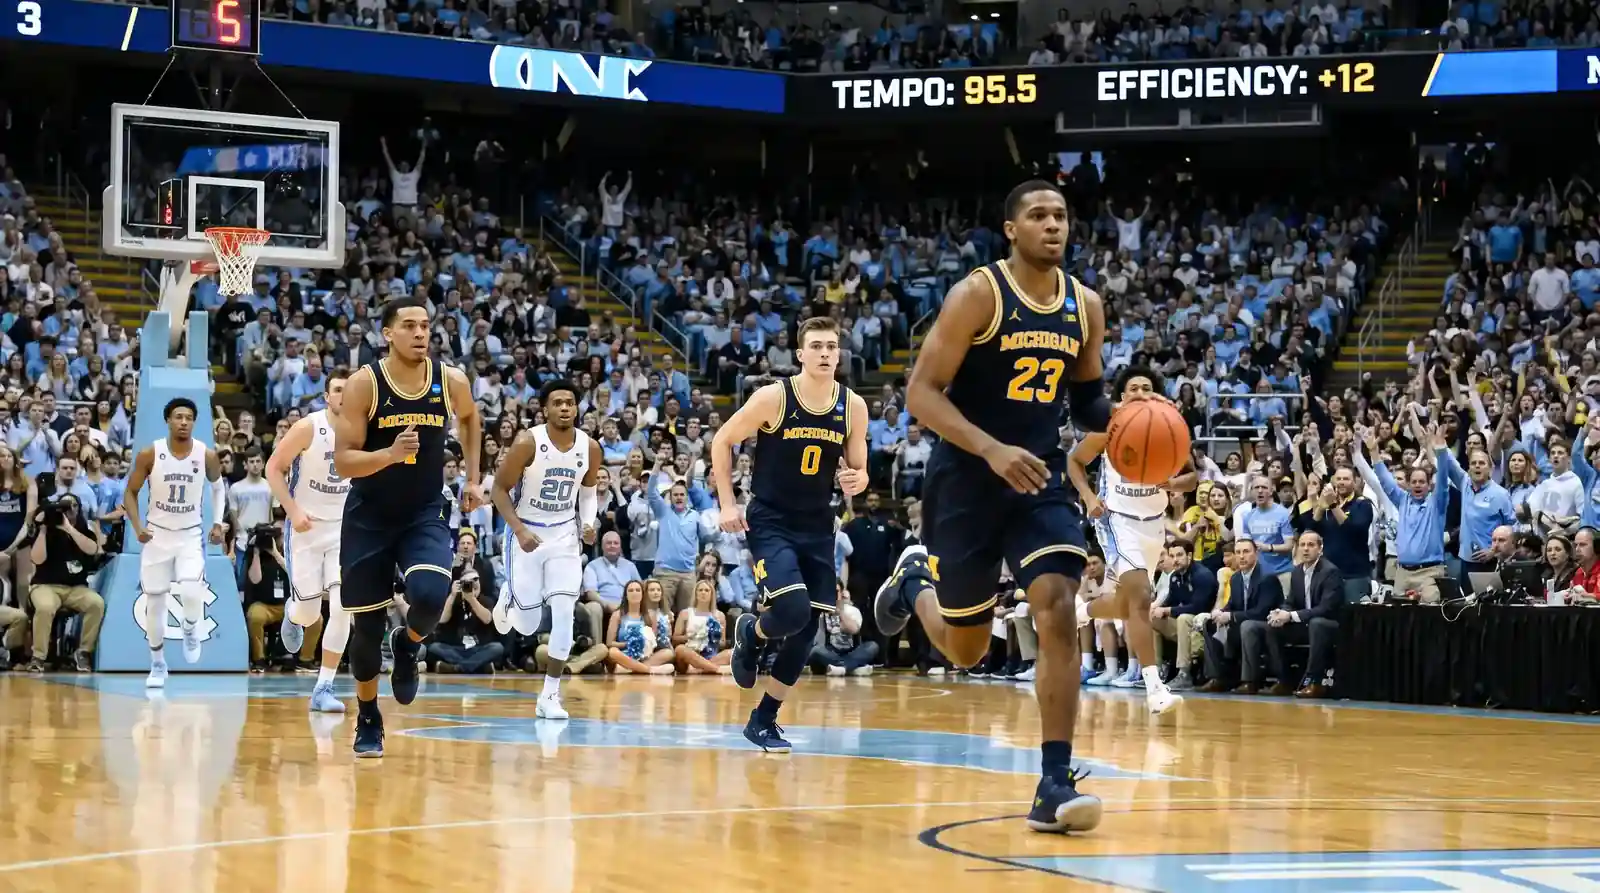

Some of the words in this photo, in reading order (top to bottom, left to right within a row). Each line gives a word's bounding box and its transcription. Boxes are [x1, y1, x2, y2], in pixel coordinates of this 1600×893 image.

[17, 1, 42, 35] 3
[217, 0, 240, 42] 5
[832, 77, 955, 108] TEMPO:
[965, 74, 1037, 105] 95.5
[1098, 64, 1307, 101] EFFICIENCY:
[1319, 62, 1374, 93] +12
[1000, 331, 1080, 359] MICHIGAN
[1007, 357, 1065, 402] 23
[378, 413, 444, 428] MICHIGAN
[783, 427, 844, 445] MICHIGAN
[801, 445, 822, 475] 0
[164, 473, 193, 483] NORTH
[545, 467, 576, 479] NORTH
[168, 484, 186, 503] 11
[540, 479, 574, 501] 20
[156, 501, 195, 513] CAROLINA
[530, 498, 573, 512] CAROLINA
